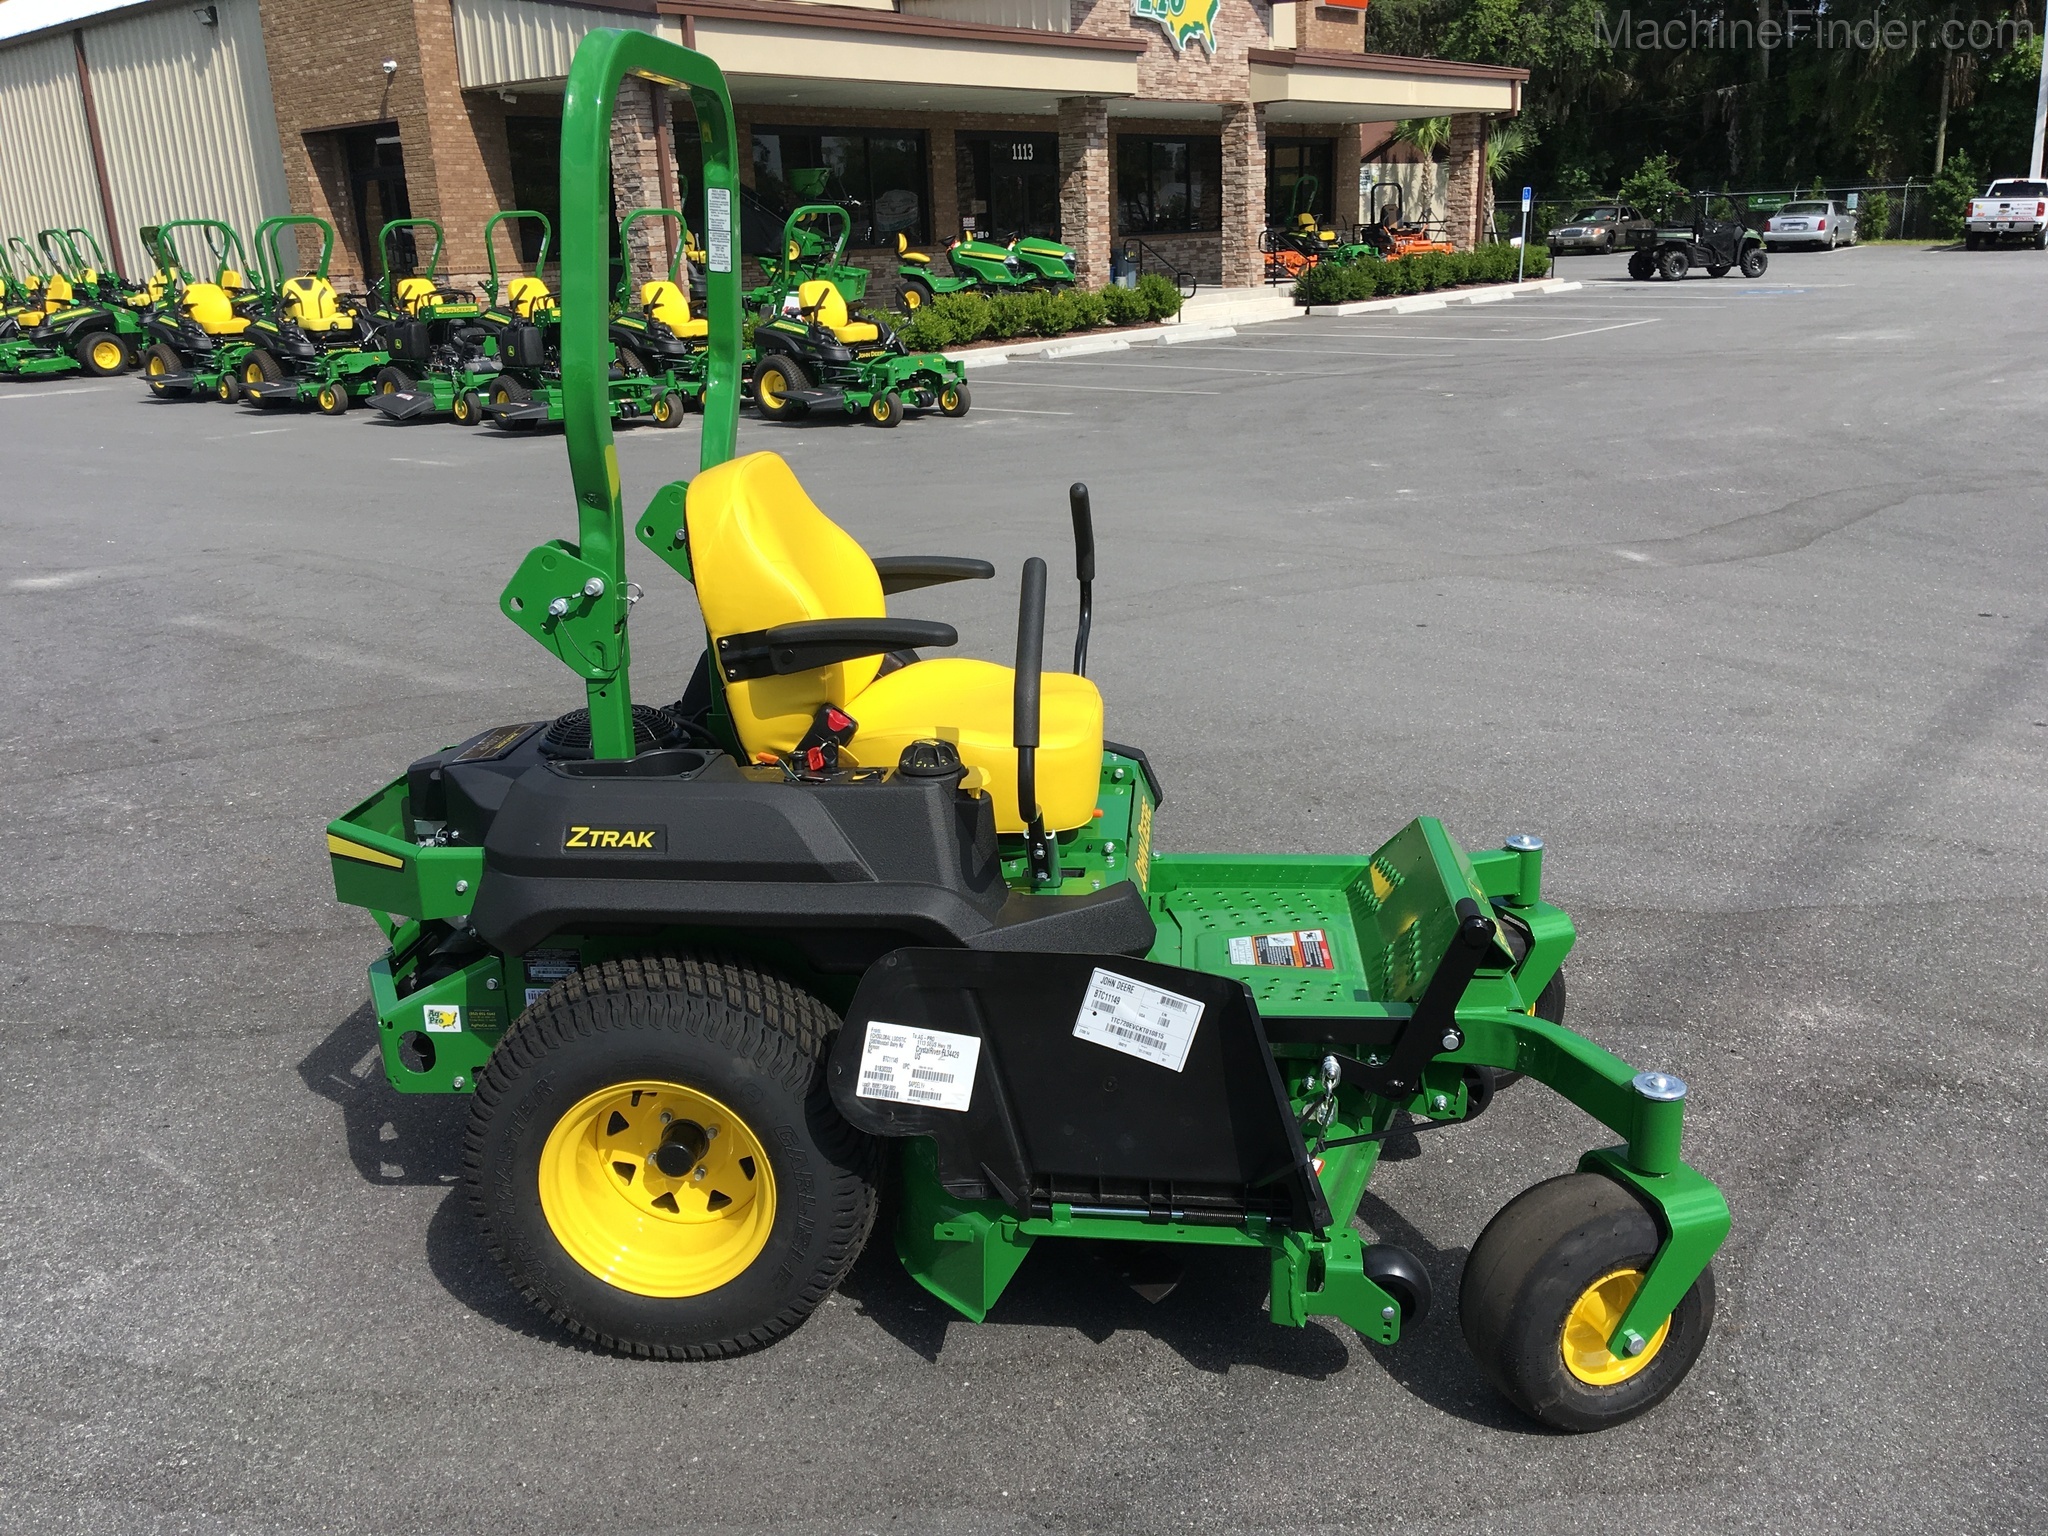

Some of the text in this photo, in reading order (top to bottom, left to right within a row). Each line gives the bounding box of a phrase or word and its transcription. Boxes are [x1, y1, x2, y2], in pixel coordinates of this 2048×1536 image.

[1012, 143, 1034, 160] 1113
[566, 826, 656, 848] ZTRAK
[1100, 976, 1135, 994] JOHN DEERE
[1094, 989, 1120, 1005] BTC11149
[774, 1123, 817, 1285] CARLISLE
